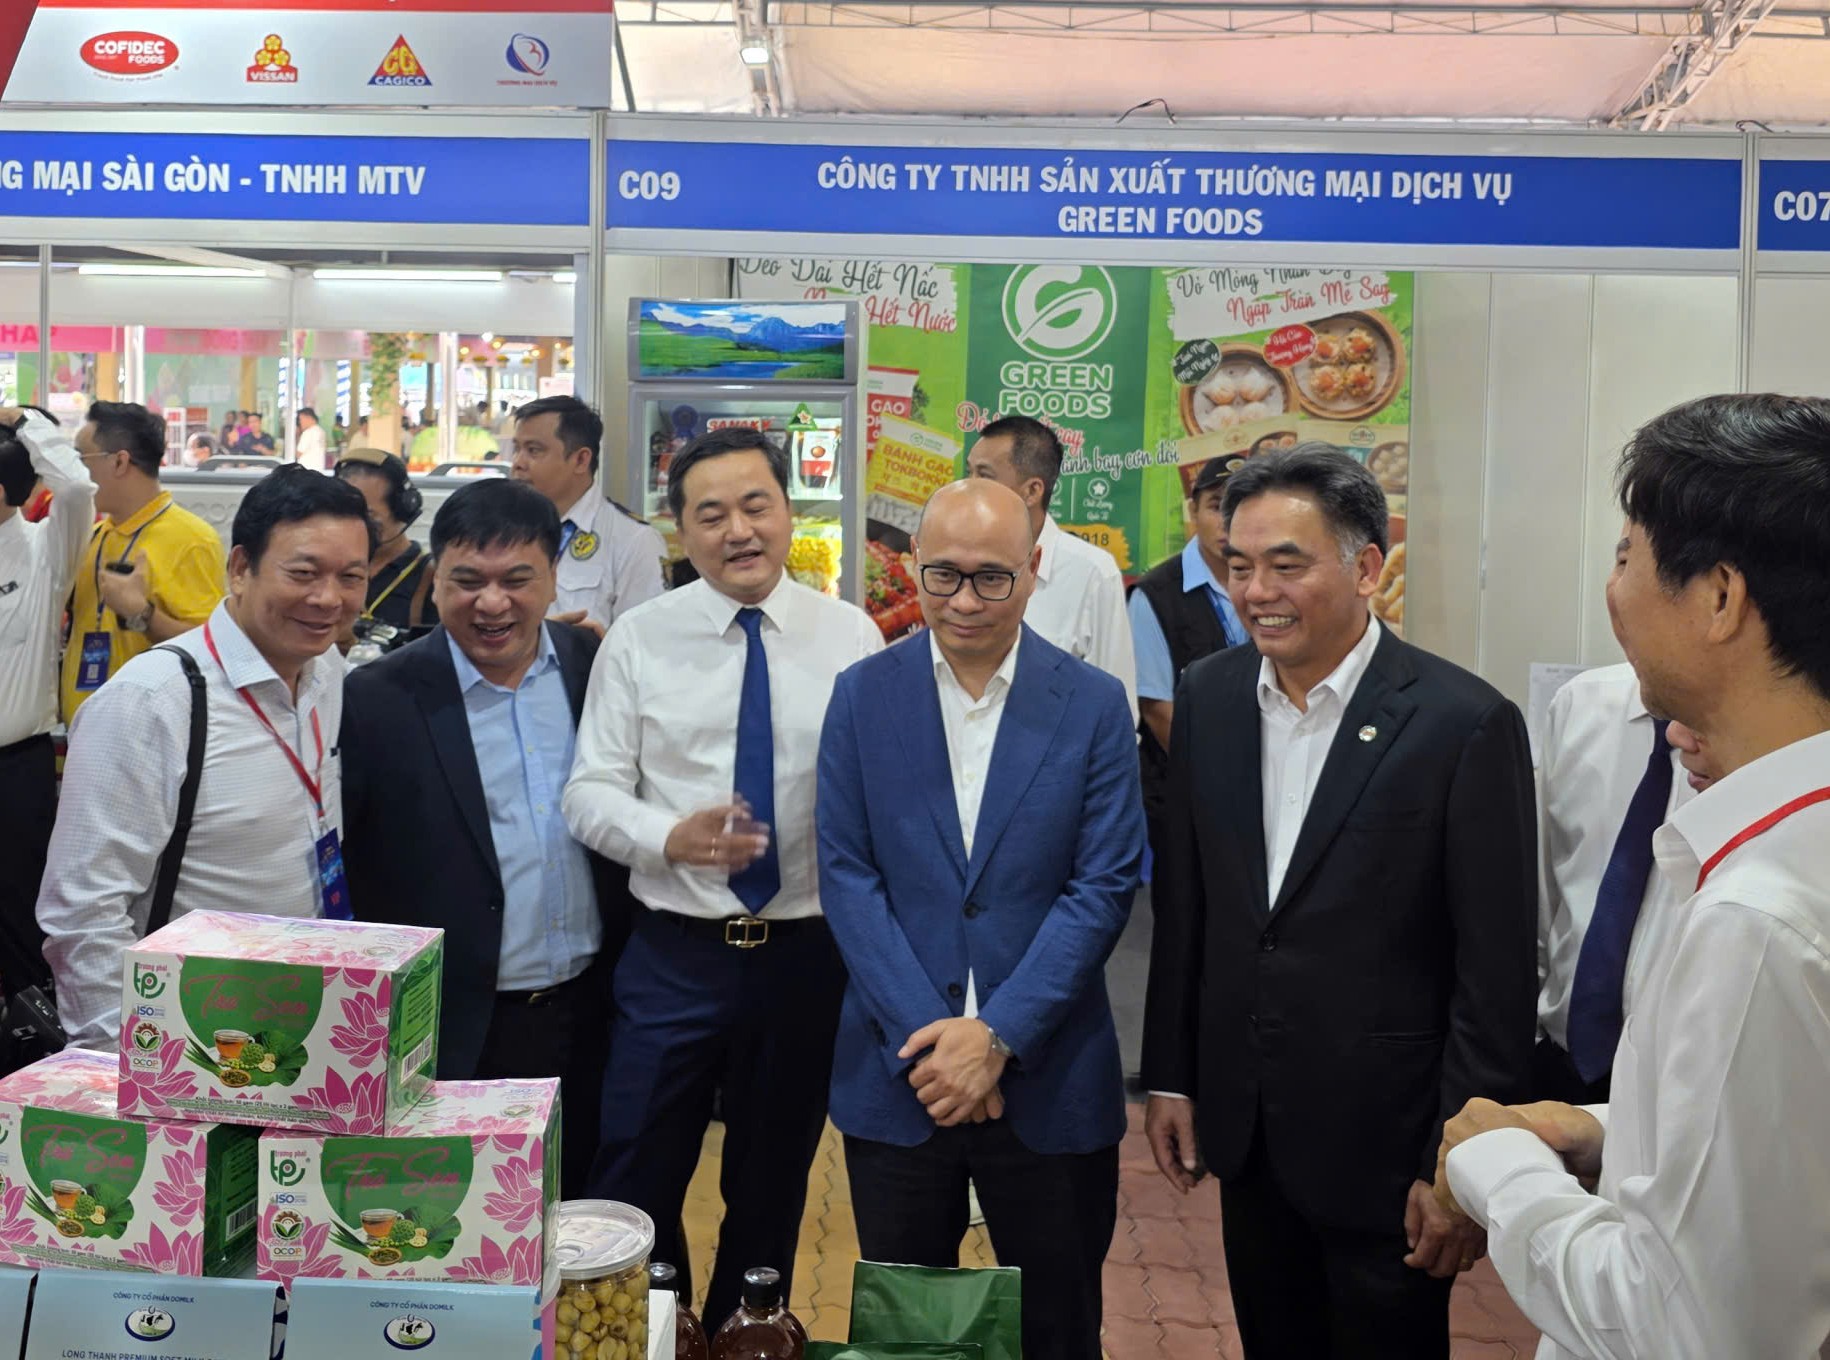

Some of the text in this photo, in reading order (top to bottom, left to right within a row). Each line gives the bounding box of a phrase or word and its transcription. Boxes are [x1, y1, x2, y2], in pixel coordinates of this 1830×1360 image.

[94, 40, 166, 55] COFIDEC
[128, 55, 165, 65] FOODS
[250, 70, 295, 82] VISSAN
[375, 76, 425, 87] CAGICO
[33, 160, 92, 196] MẠI
[102, 154, 153, 191] SÀI
[164, 155, 229, 192] GÒN
[260, 164, 346, 194] TNHH
[358, 165, 426, 195] MTV
[817, 155, 1513, 206] CÔNG TY TNHH SẢN XUẤT THƯƠNG MẠI DỊCH VỤ
[618, 170, 681, 201] C09
[1057, 205, 1263, 236] GREEN FOODS
[908, 302, 957, 334] Nước
[1000, 361, 1113, 391] GREEN
[999, 390, 1111, 418] FOODS
[137, 1005, 154, 1016] ISO
[133, 1058, 158, 1067] OCOP
[275, 1194, 295, 1204] ISO
[273, 1247, 302, 1255] OCOP
[370, 1300, 390, 1309] CÔNG
[429, 1303, 454, 1311] DOMILK
[62, 1350, 85, 1359] LONG
[88, 1351, 117, 1360] THANH
